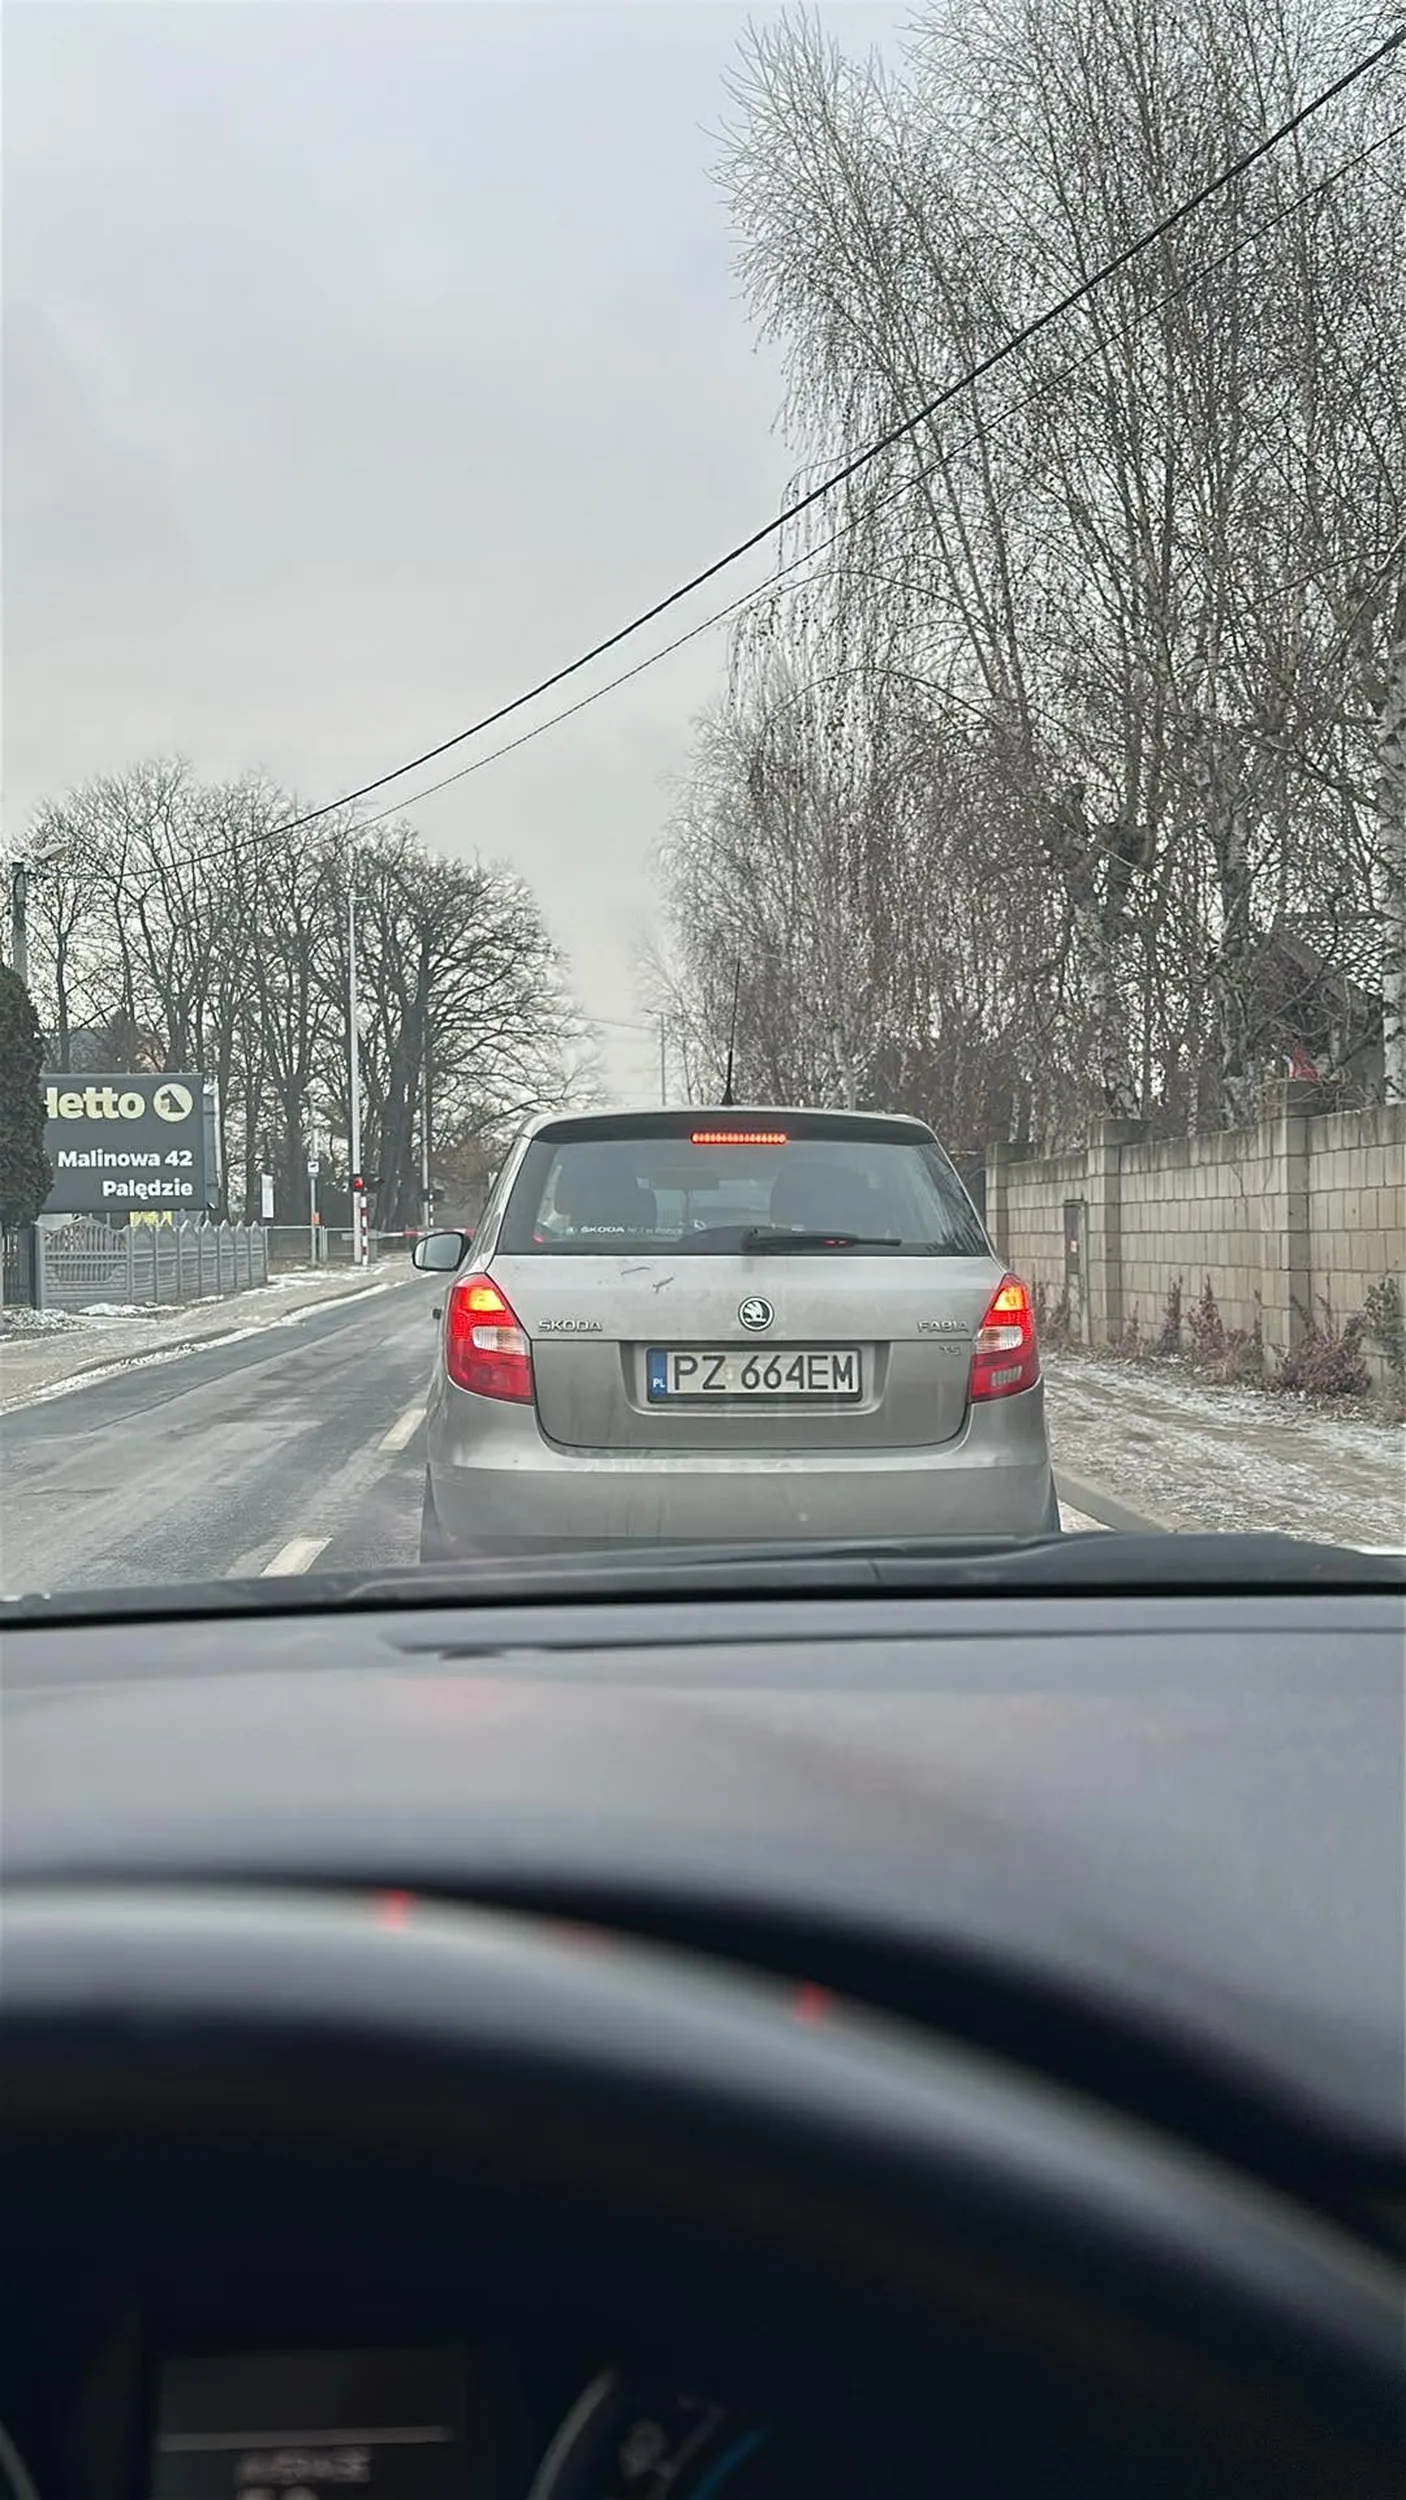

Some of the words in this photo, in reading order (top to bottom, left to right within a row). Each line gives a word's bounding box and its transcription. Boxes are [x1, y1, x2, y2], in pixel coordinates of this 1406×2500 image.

[58, 1149, 161, 1168] Malinowa
[165, 1151, 193, 1167] 42
[103, 1178, 194, 1200] Palędzie
[917, 1320, 969, 1333] FABIA
[653, 1378, 665, 1388] PL
[674, 1355, 727, 1391] PZ
[740, 1355, 854, 1391] 664EM
